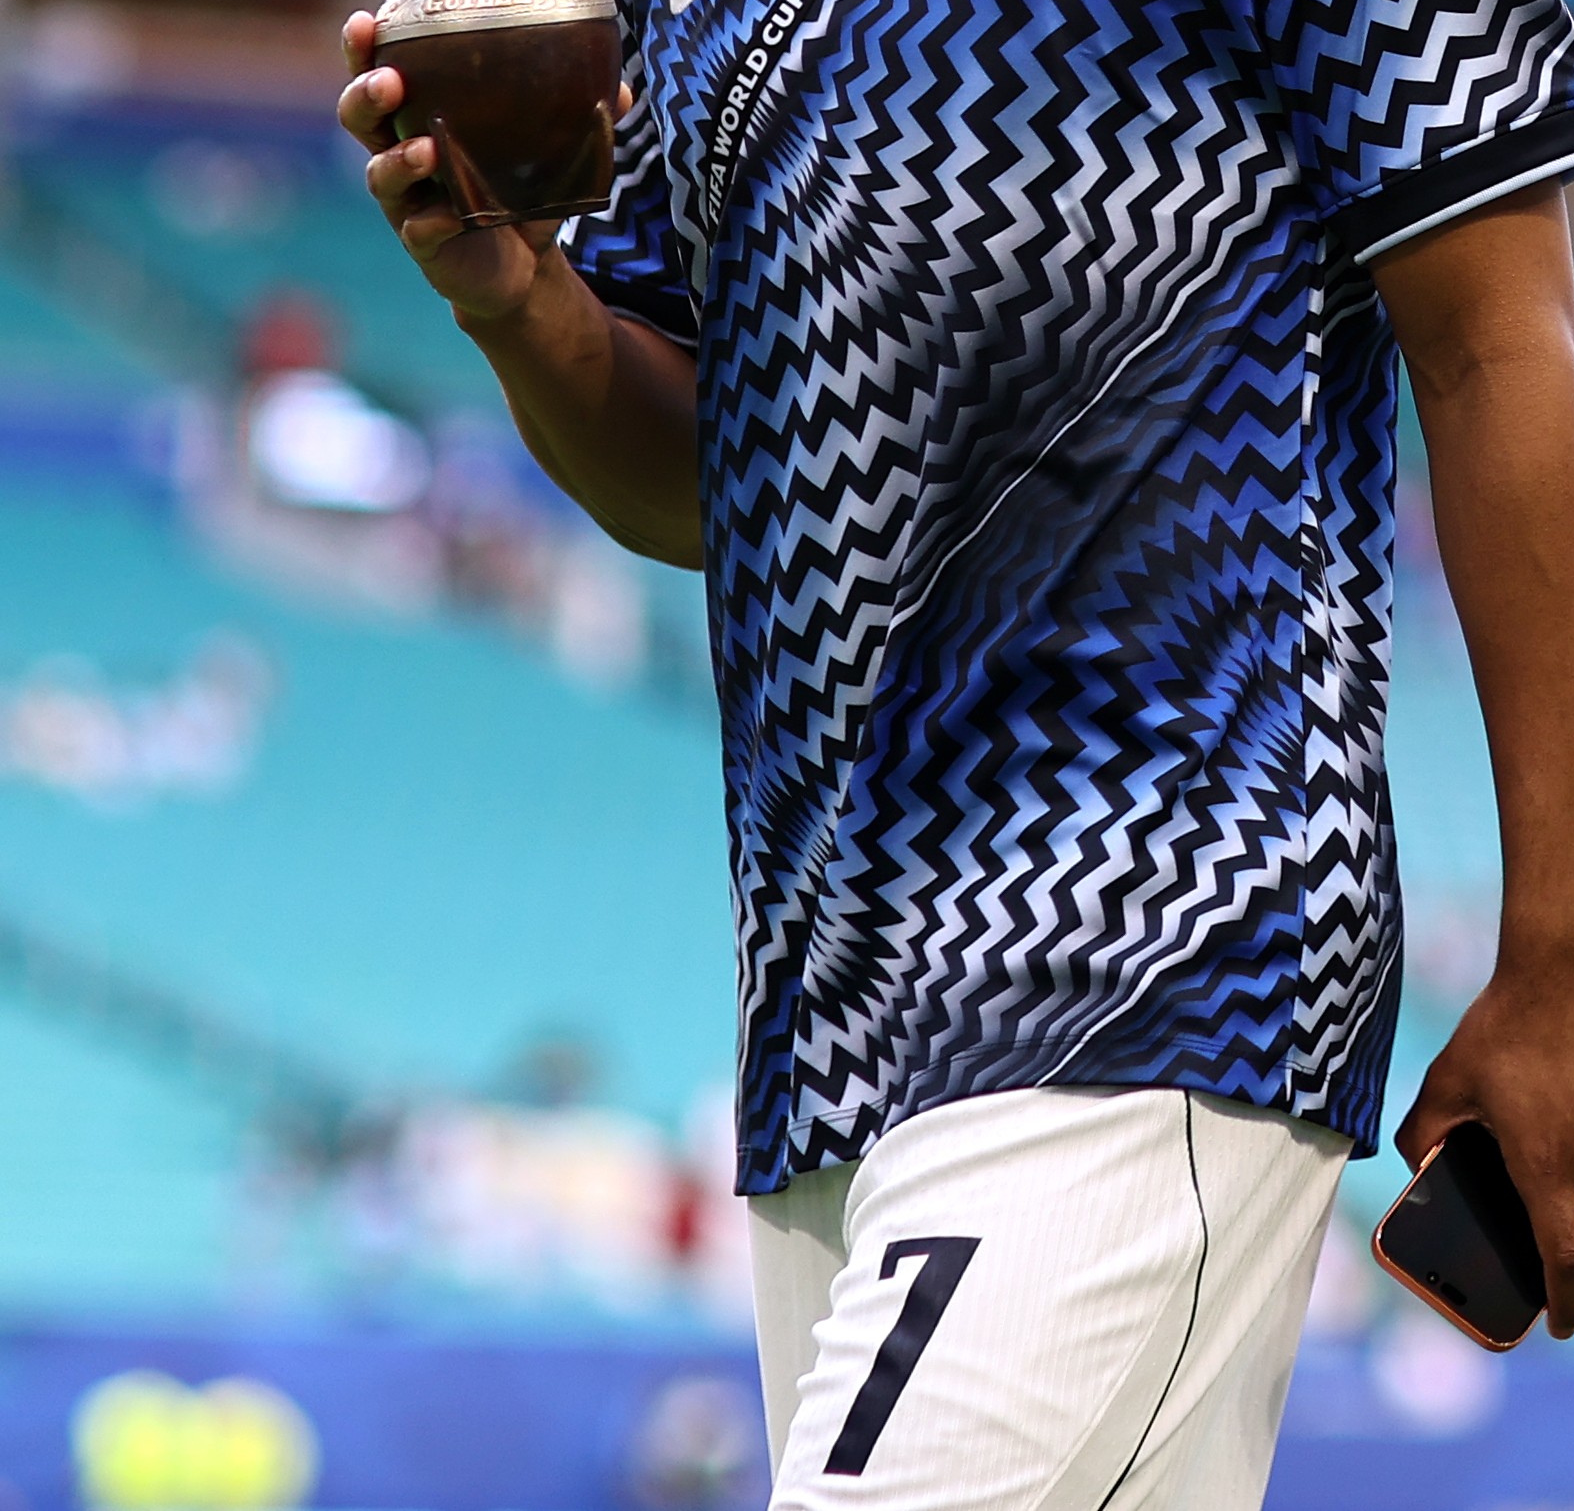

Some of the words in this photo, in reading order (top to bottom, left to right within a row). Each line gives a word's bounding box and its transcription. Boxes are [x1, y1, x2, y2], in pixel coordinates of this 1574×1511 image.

[713, 48, 768, 157] WORLD
[709, 162, 727, 226] FIFA
[823, 1237, 982, 1476] 7
